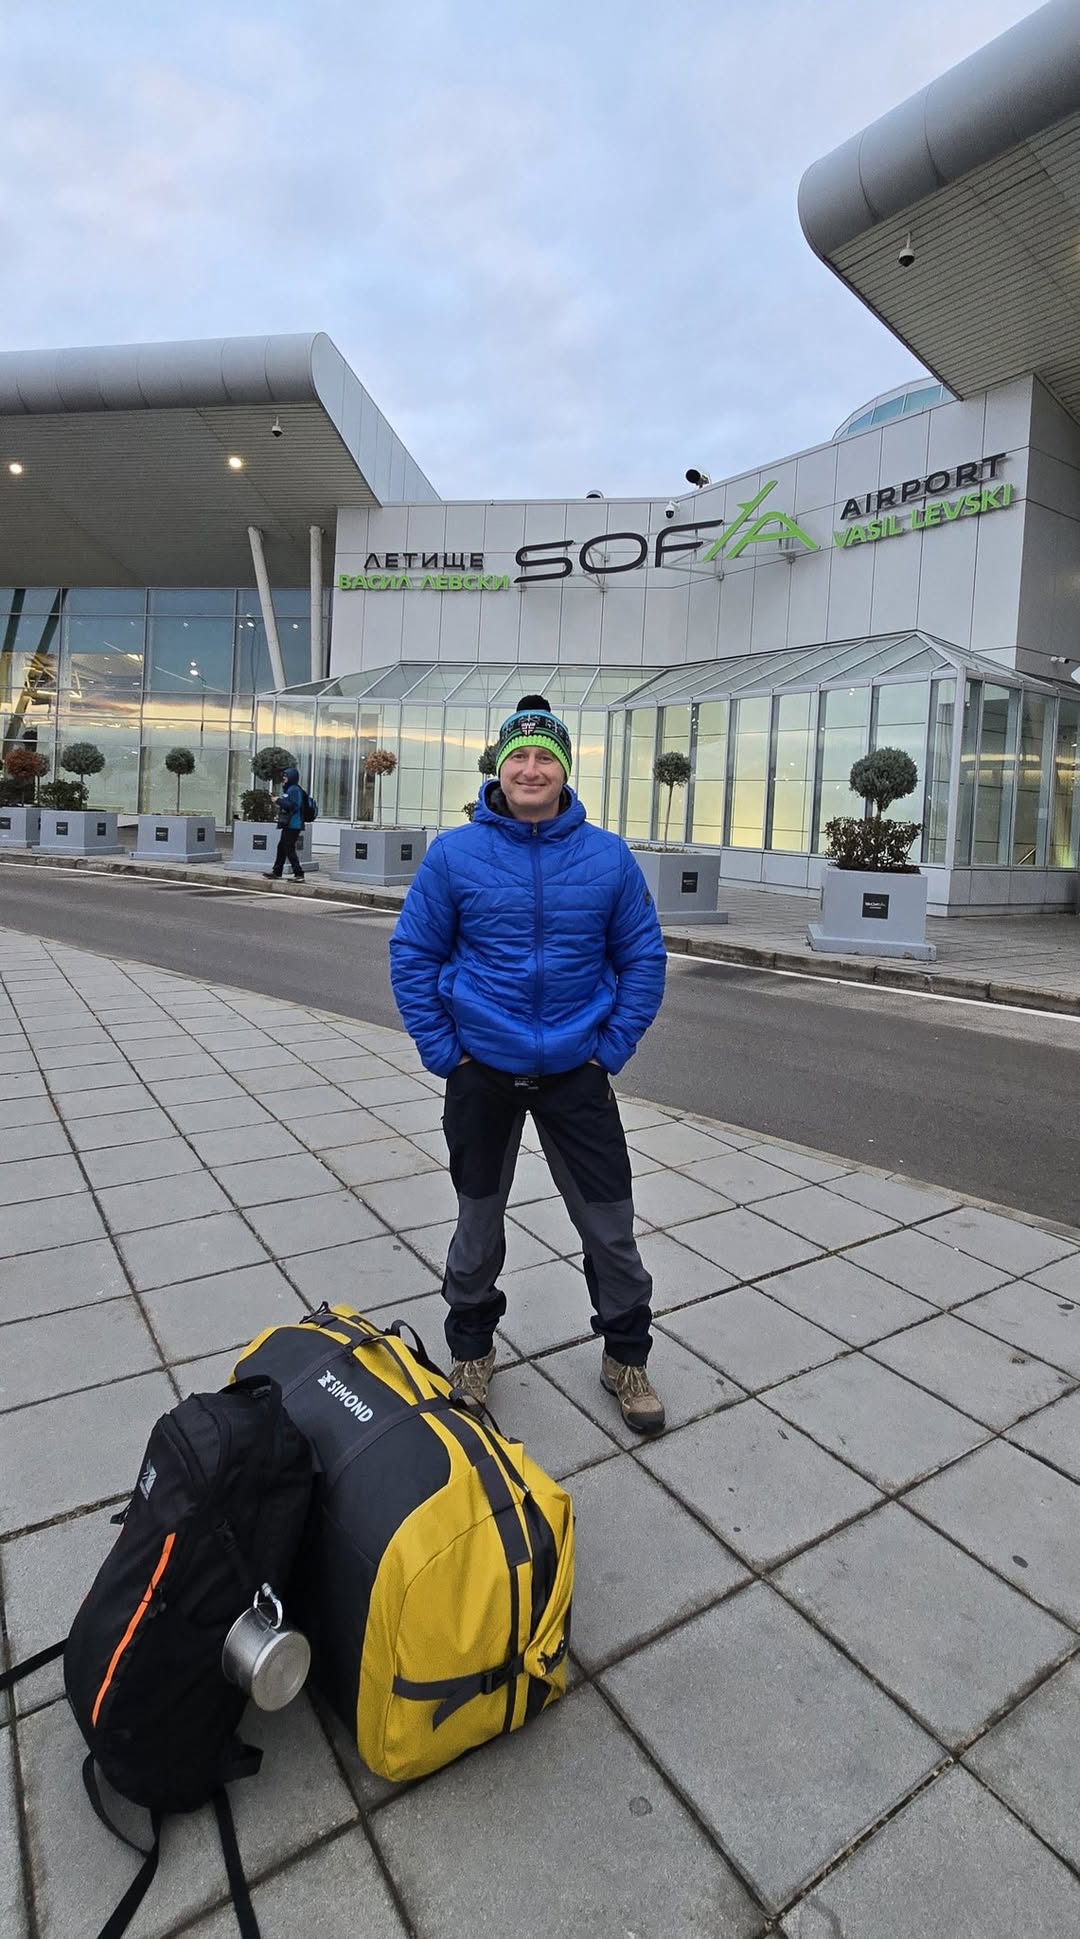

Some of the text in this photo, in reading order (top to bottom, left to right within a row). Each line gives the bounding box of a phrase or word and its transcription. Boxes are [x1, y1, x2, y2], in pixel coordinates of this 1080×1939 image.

[840, 453, 1007, 520] AIRPORT
[514, 480, 821, 583] SOFIA
[832, 483, 1014, 549] VASIL LEVSKI
[338, 573, 509, 592] ВАСИЛ ЛЕВСКИ
[364, 552, 484, 571] ЛЕТИЩЕ
[327, 1380, 374, 1422] SIMOND
